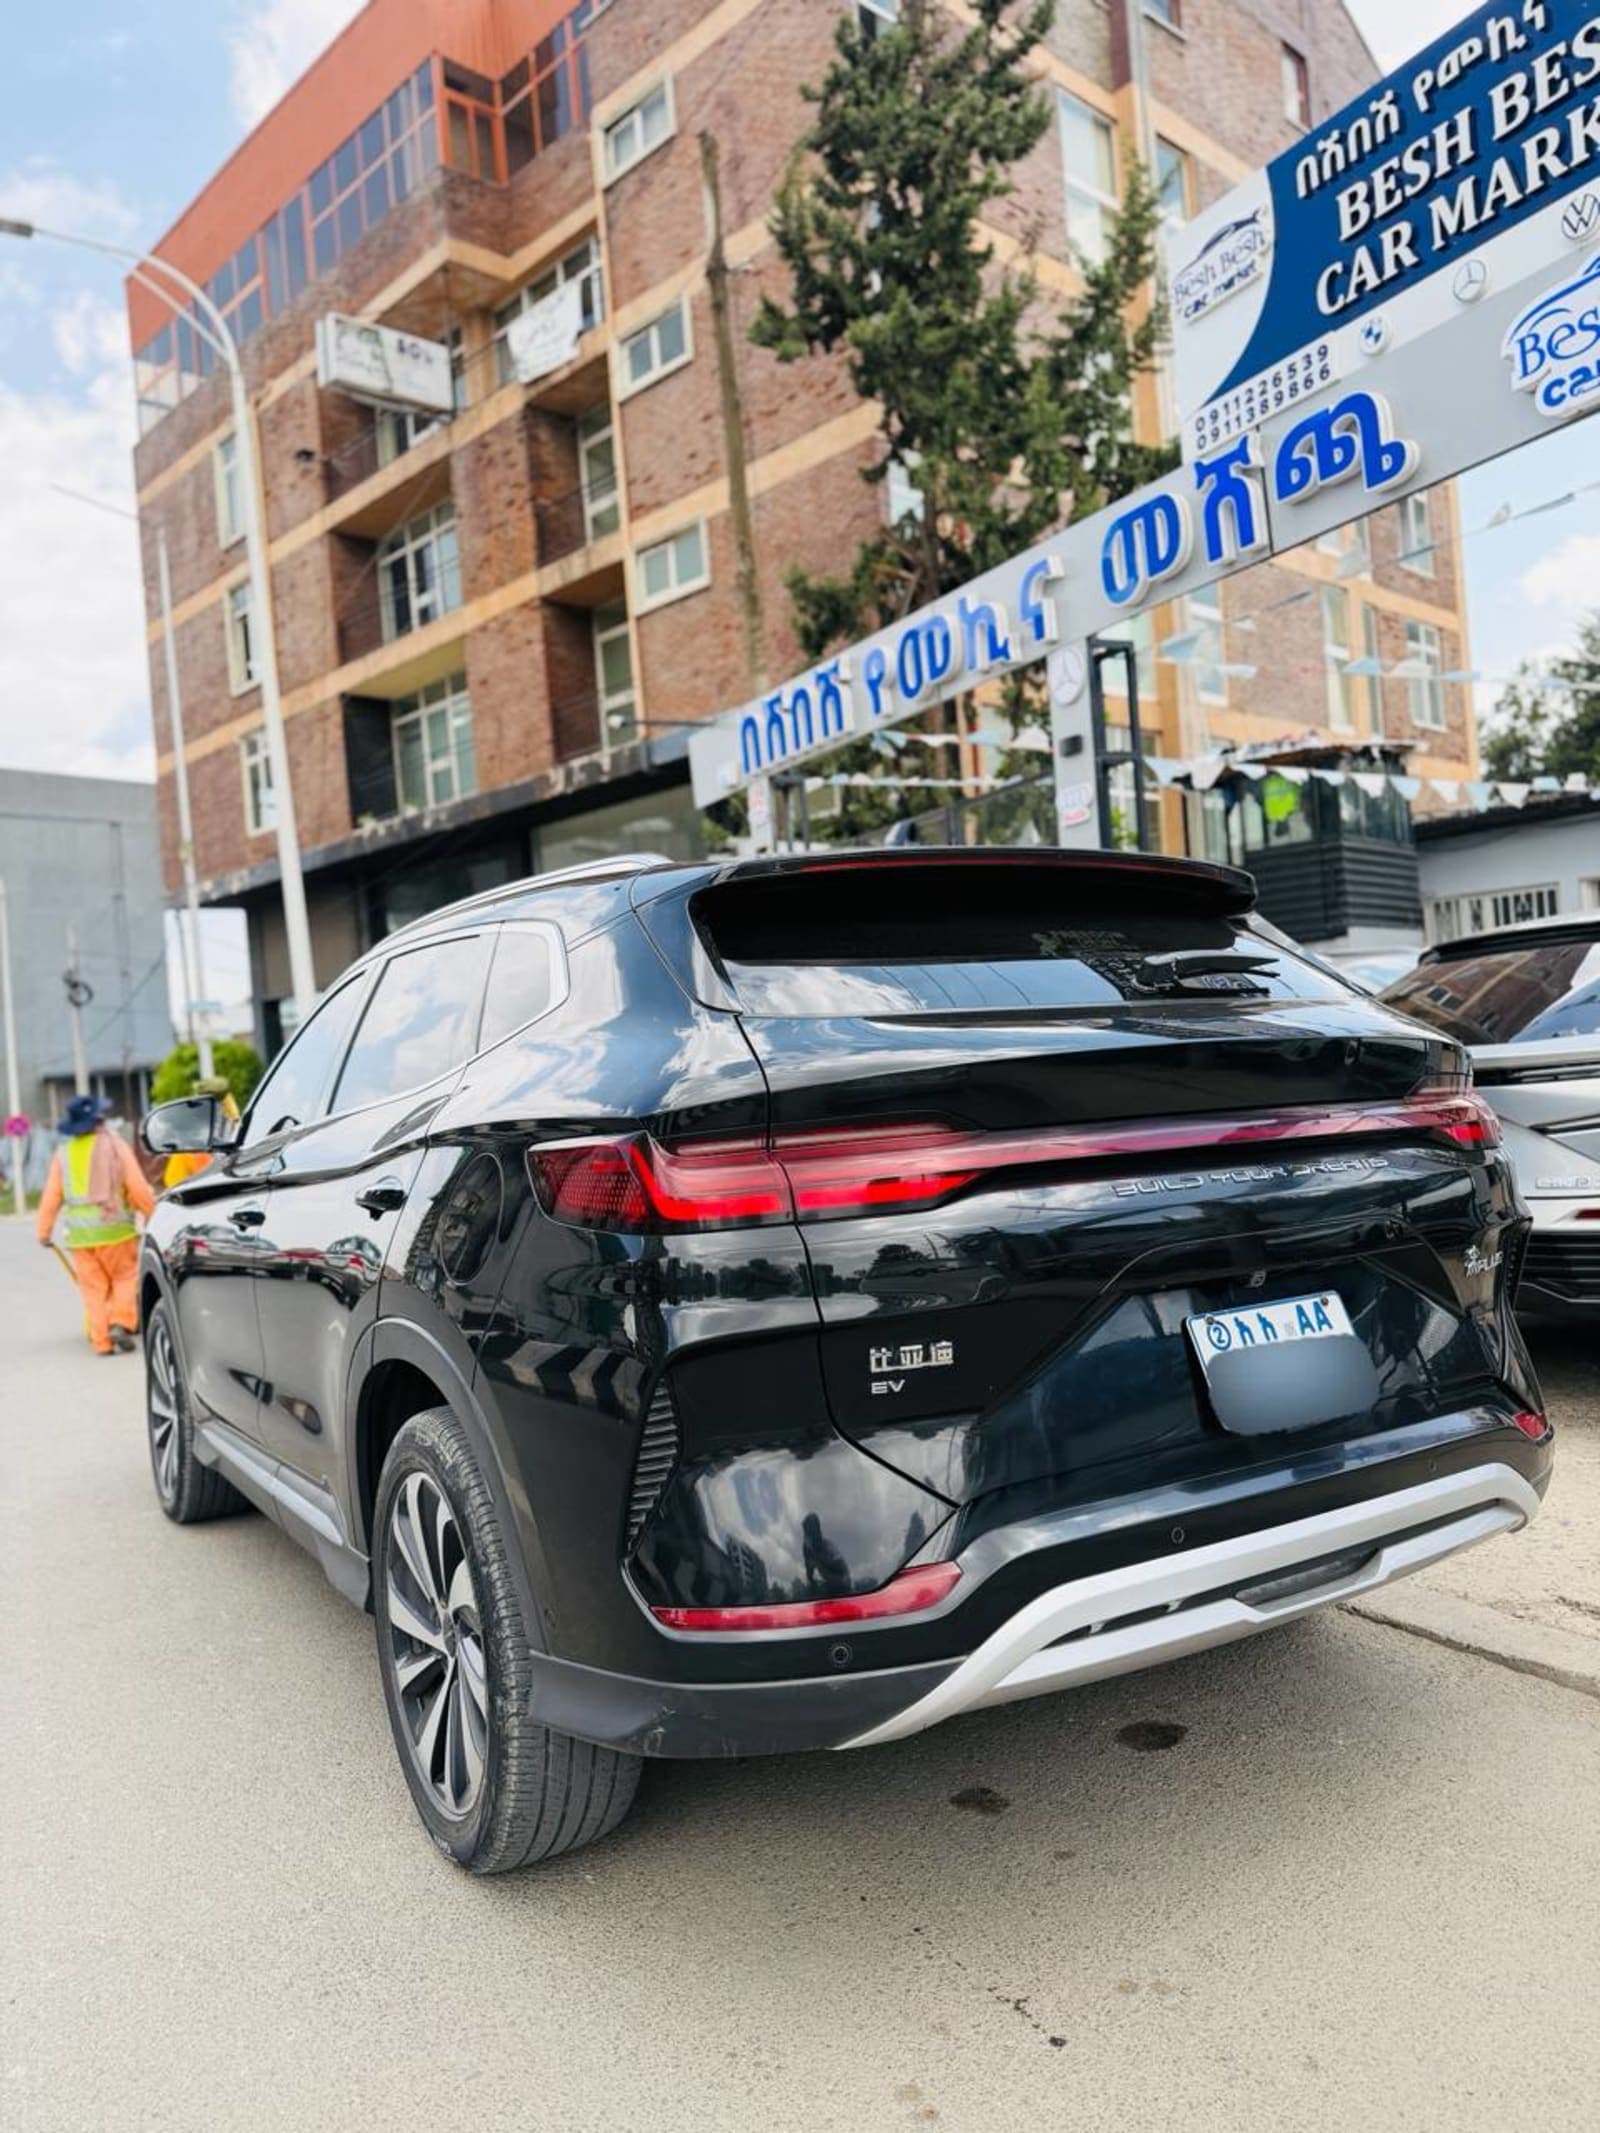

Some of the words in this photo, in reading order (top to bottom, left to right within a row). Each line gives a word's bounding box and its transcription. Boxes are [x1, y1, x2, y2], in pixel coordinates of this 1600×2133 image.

[1336, 106, 1475, 242] BESH
[1316, 220, 1420, 316] CAR
[1195, 344, 1329, 432] 0911226539
[1542, 360, 1600, 408] ca
[1113, 1174, 1204, 1198] BUILD
[1210, 1165, 1288, 1185] YOUR
[1295, 1300, 1334, 1336] AA
[871, 1379, 906, 1394] EV
